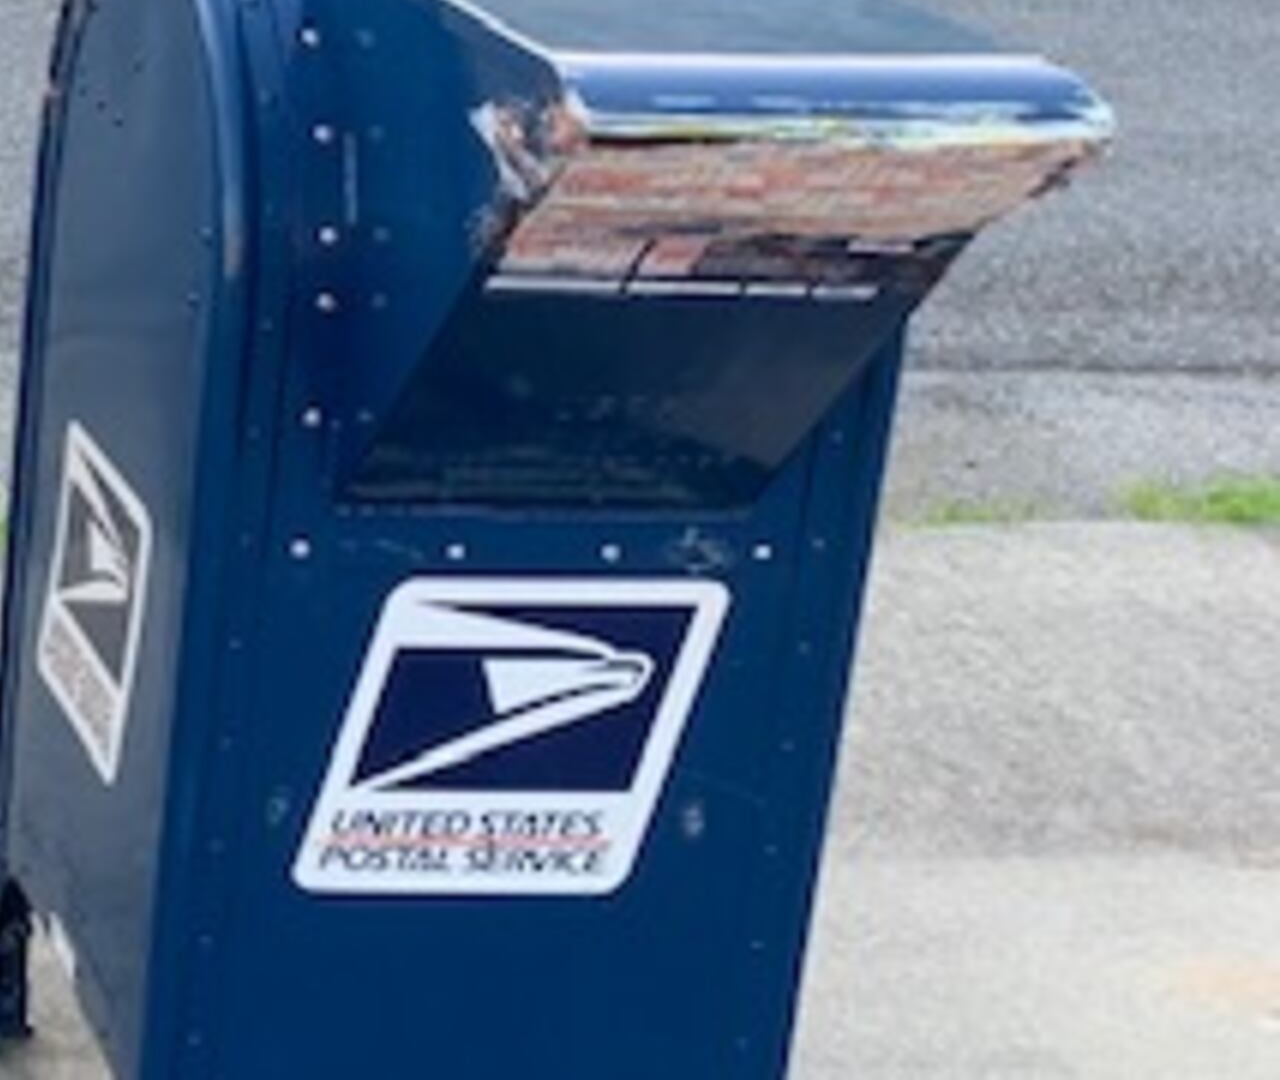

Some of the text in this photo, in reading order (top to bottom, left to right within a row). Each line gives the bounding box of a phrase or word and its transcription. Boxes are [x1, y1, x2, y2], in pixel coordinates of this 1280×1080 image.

[332, 810, 604, 837] UNITED STATES
[318, 845, 605, 873] POSTAL SERVICE
